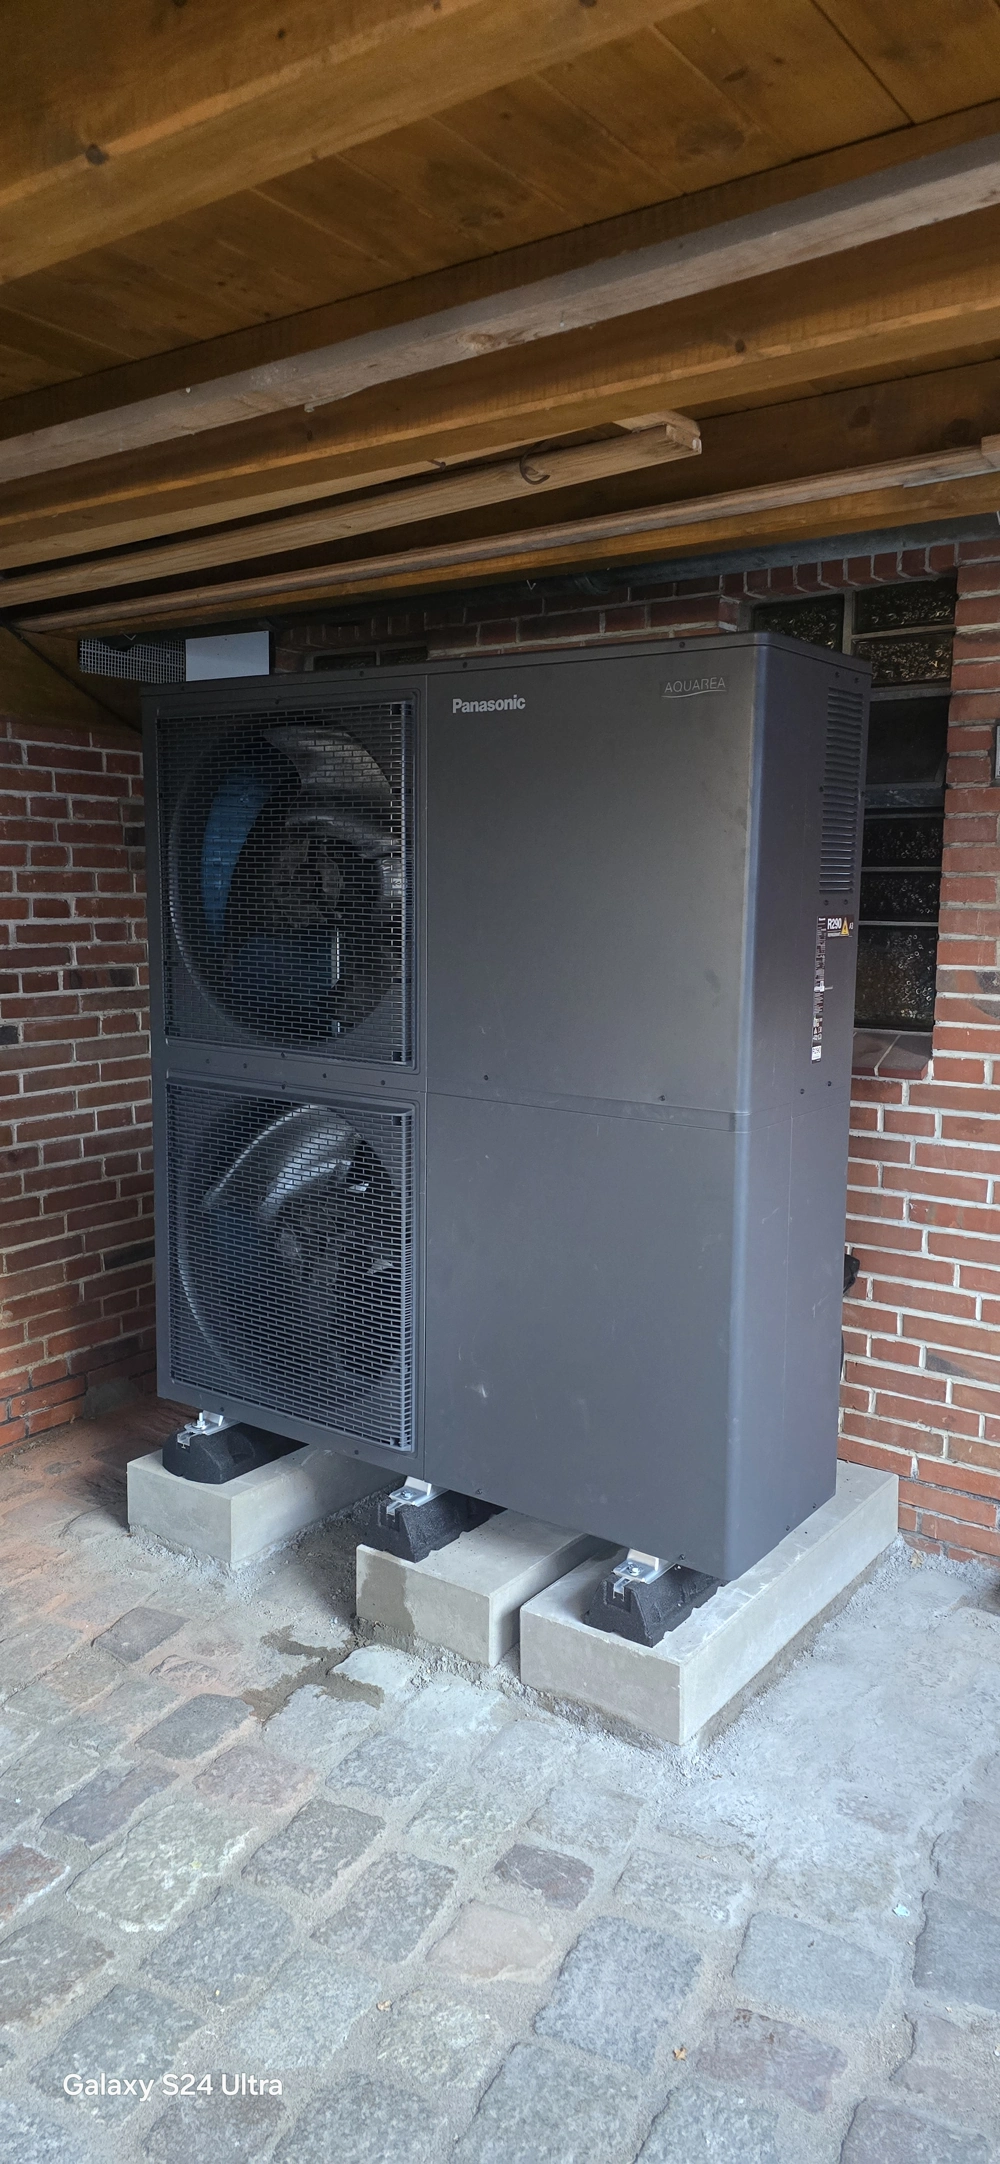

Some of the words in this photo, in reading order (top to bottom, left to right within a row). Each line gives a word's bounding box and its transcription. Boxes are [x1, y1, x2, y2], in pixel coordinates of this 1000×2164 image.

[664, 677, 726, 694] AQUAREA
[452, 694, 526, 714] Panasonic
[827, 917, 842, 930] R290
